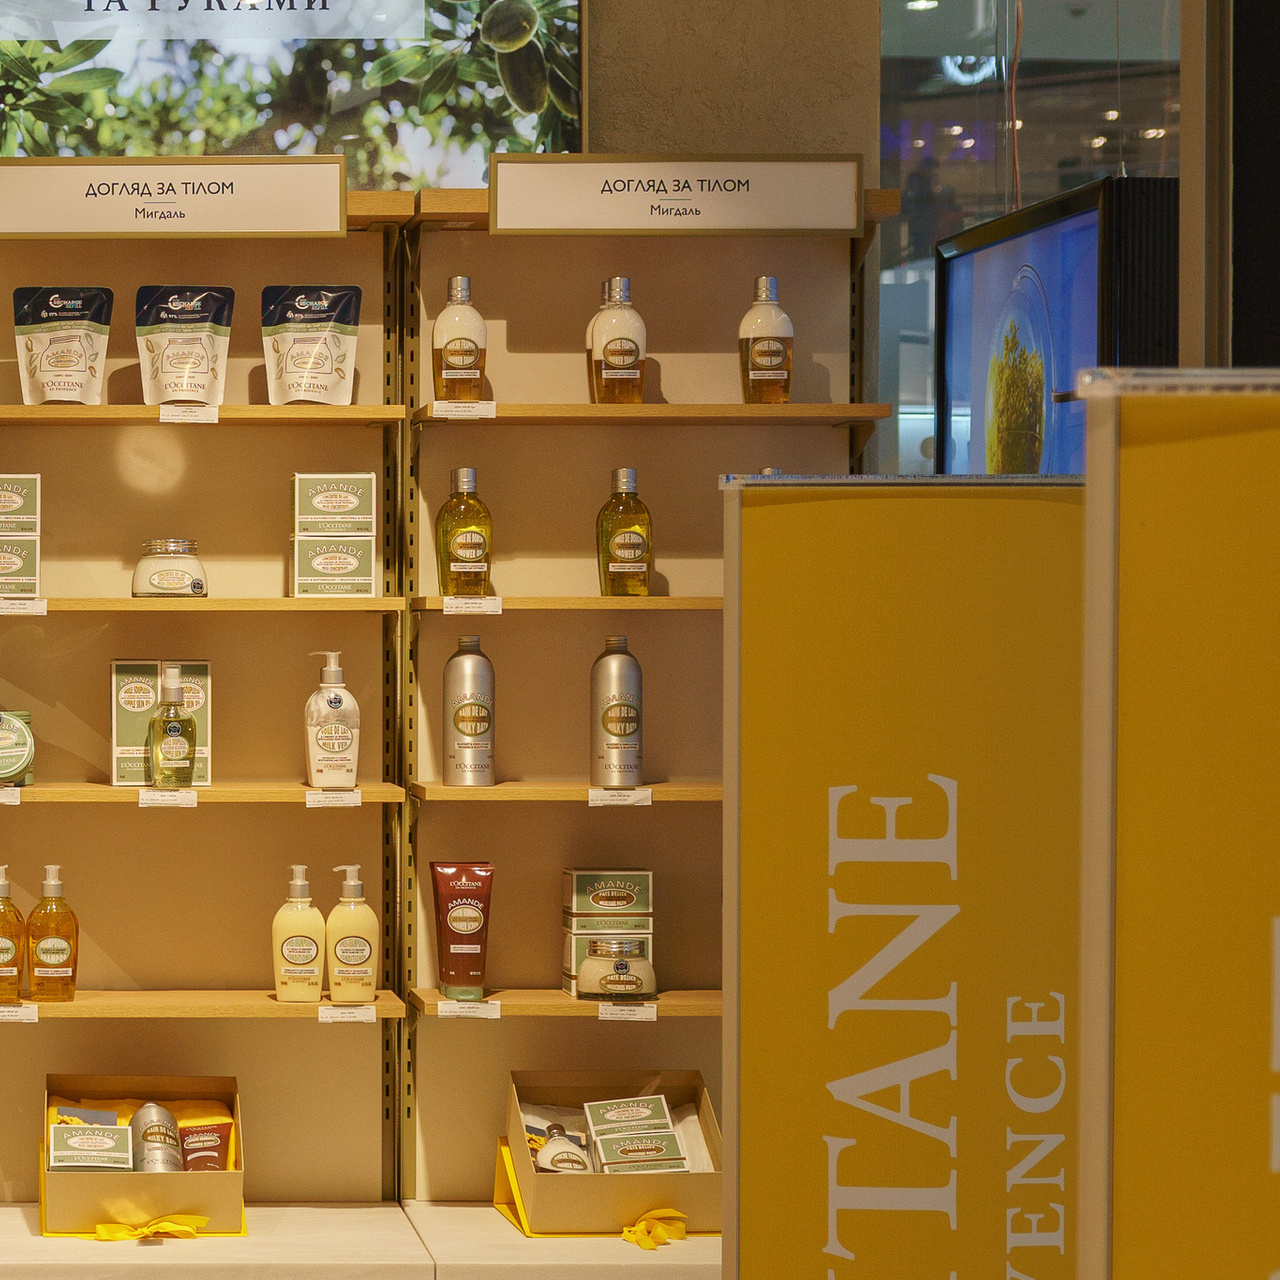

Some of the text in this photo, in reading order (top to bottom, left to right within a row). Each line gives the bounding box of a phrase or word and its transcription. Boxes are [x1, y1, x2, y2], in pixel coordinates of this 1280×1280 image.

[85, 181, 234, 197] ДОГЛЯД ЗА ТІЛОМ
[601, 179, 750, 194] ДОГЛЯД ЗА ТІЛОМ
[134, 208, 185, 220] Мигдаль
[650, 204, 701, 218] Мигдаль
[42, 380, 83, 388] L'OCCITANE
[164, 382, 205, 390] L'OCCITANE
[308, 483, 364, 497] AMANDE
[308, 545, 364, 558] AMANDE
[120, 677, 155, 687] AMANDE
[322, 741, 335, 750] MILK
[586, 880, 642, 894] AMANDE
[448, 898, 484, 909] AMANDE
[599, 1102, 655, 1114] AMANDE
[63, 1130, 120, 1141] AMANDE
[612, 1138, 669, 1150] AMANDE
